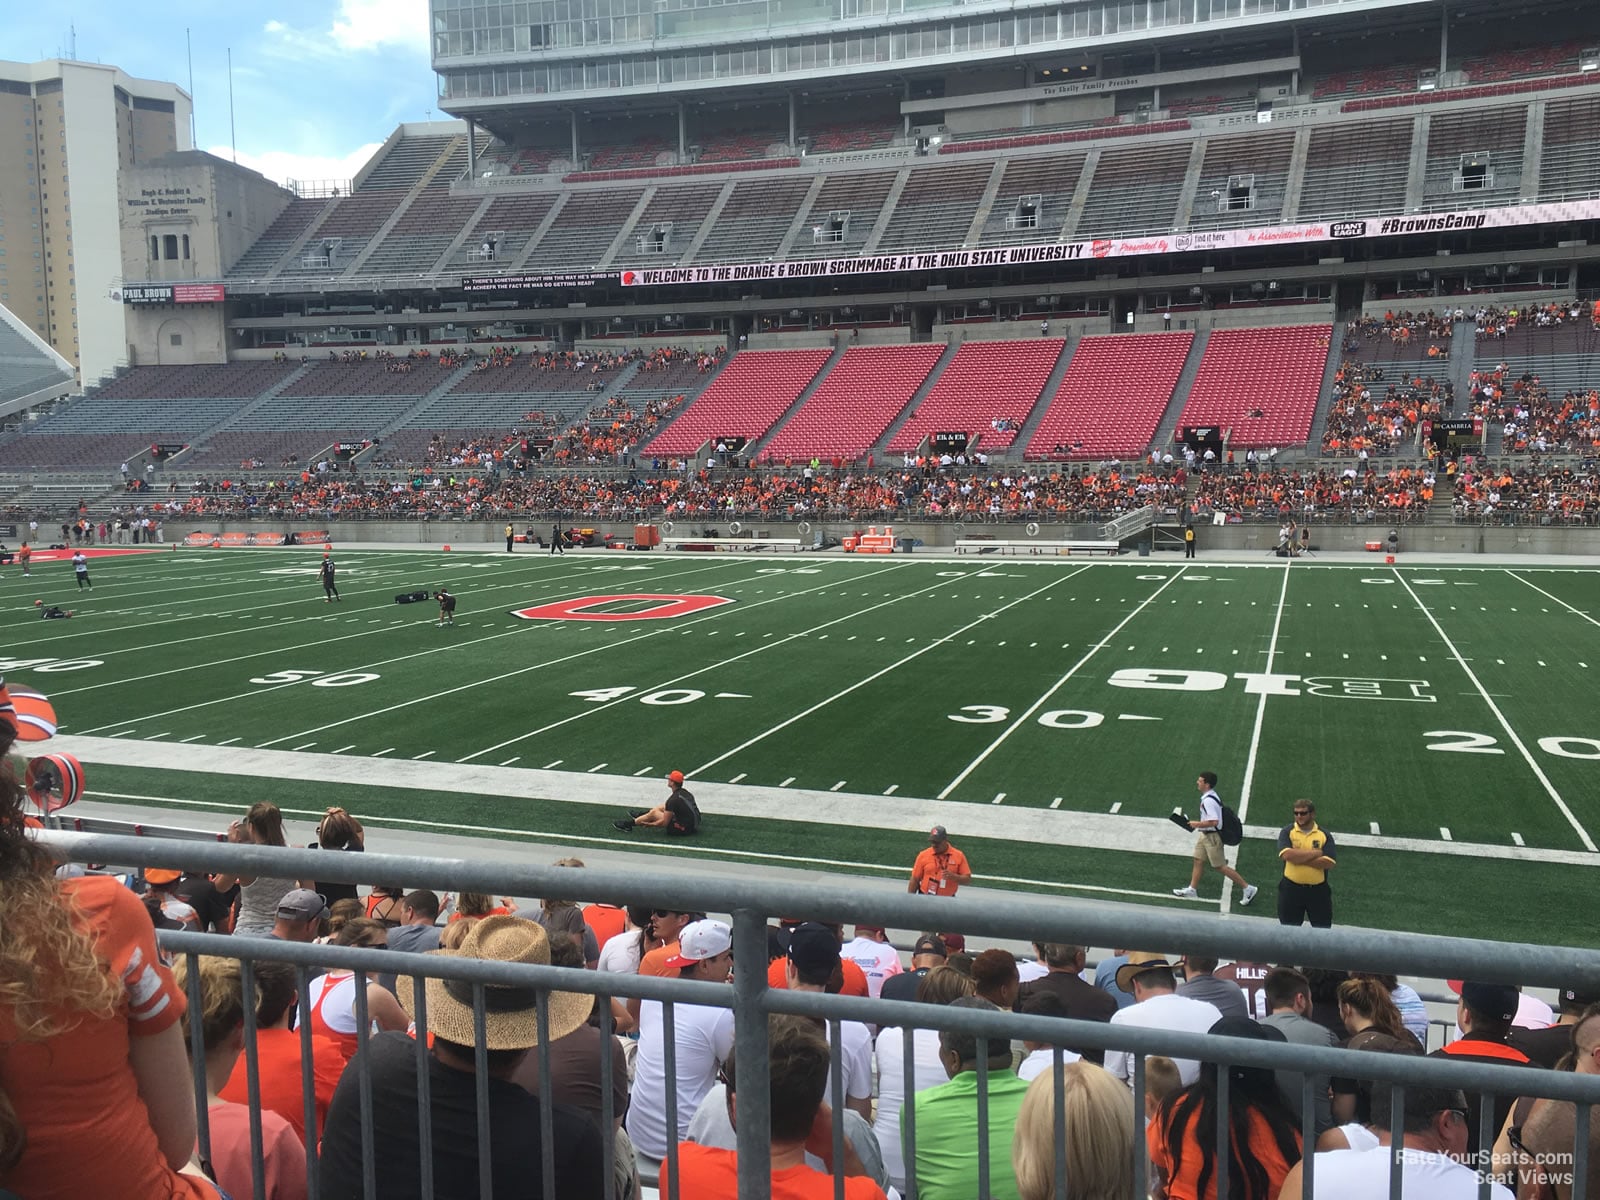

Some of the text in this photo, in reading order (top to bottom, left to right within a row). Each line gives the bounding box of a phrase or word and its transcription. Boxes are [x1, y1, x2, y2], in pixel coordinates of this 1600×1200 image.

[1334, 222, 1364, 230] GIANT
[1380, 214, 1486, 234] #BrownsCamp
[1258, 230, 1303, 240] Association
[1334, 229, 1363, 237] EAGLE
[1120, 241, 1156, 252] Presented
[1158, 240, 1168, 253] By
[643, 270, 692, 284] WELCOME
[696, 268, 708, 282] TO
[712, 267, 731, 280] THE
[734, 264, 775, 279] ORANGE
[778, 264, 785, 276] &
[788, 262, 828, 276] BROWN
[830, 257, 897, 274] SCRIMMAGE
[900, 256, 914, 270] AT
[917, 254, 938, 268] THE
[941, 252, 969, 267] OHIO
[971, 250, 1007, 265] STATE
[1010, 244, 1084, 263] UNIVERSITY
[123, 288, 144, 299] PAUL
[144, 288, 172, 298] BROWN
[947, 705, 1105, 729] 30
[1236, 968, 1268, 980] HILLIS
